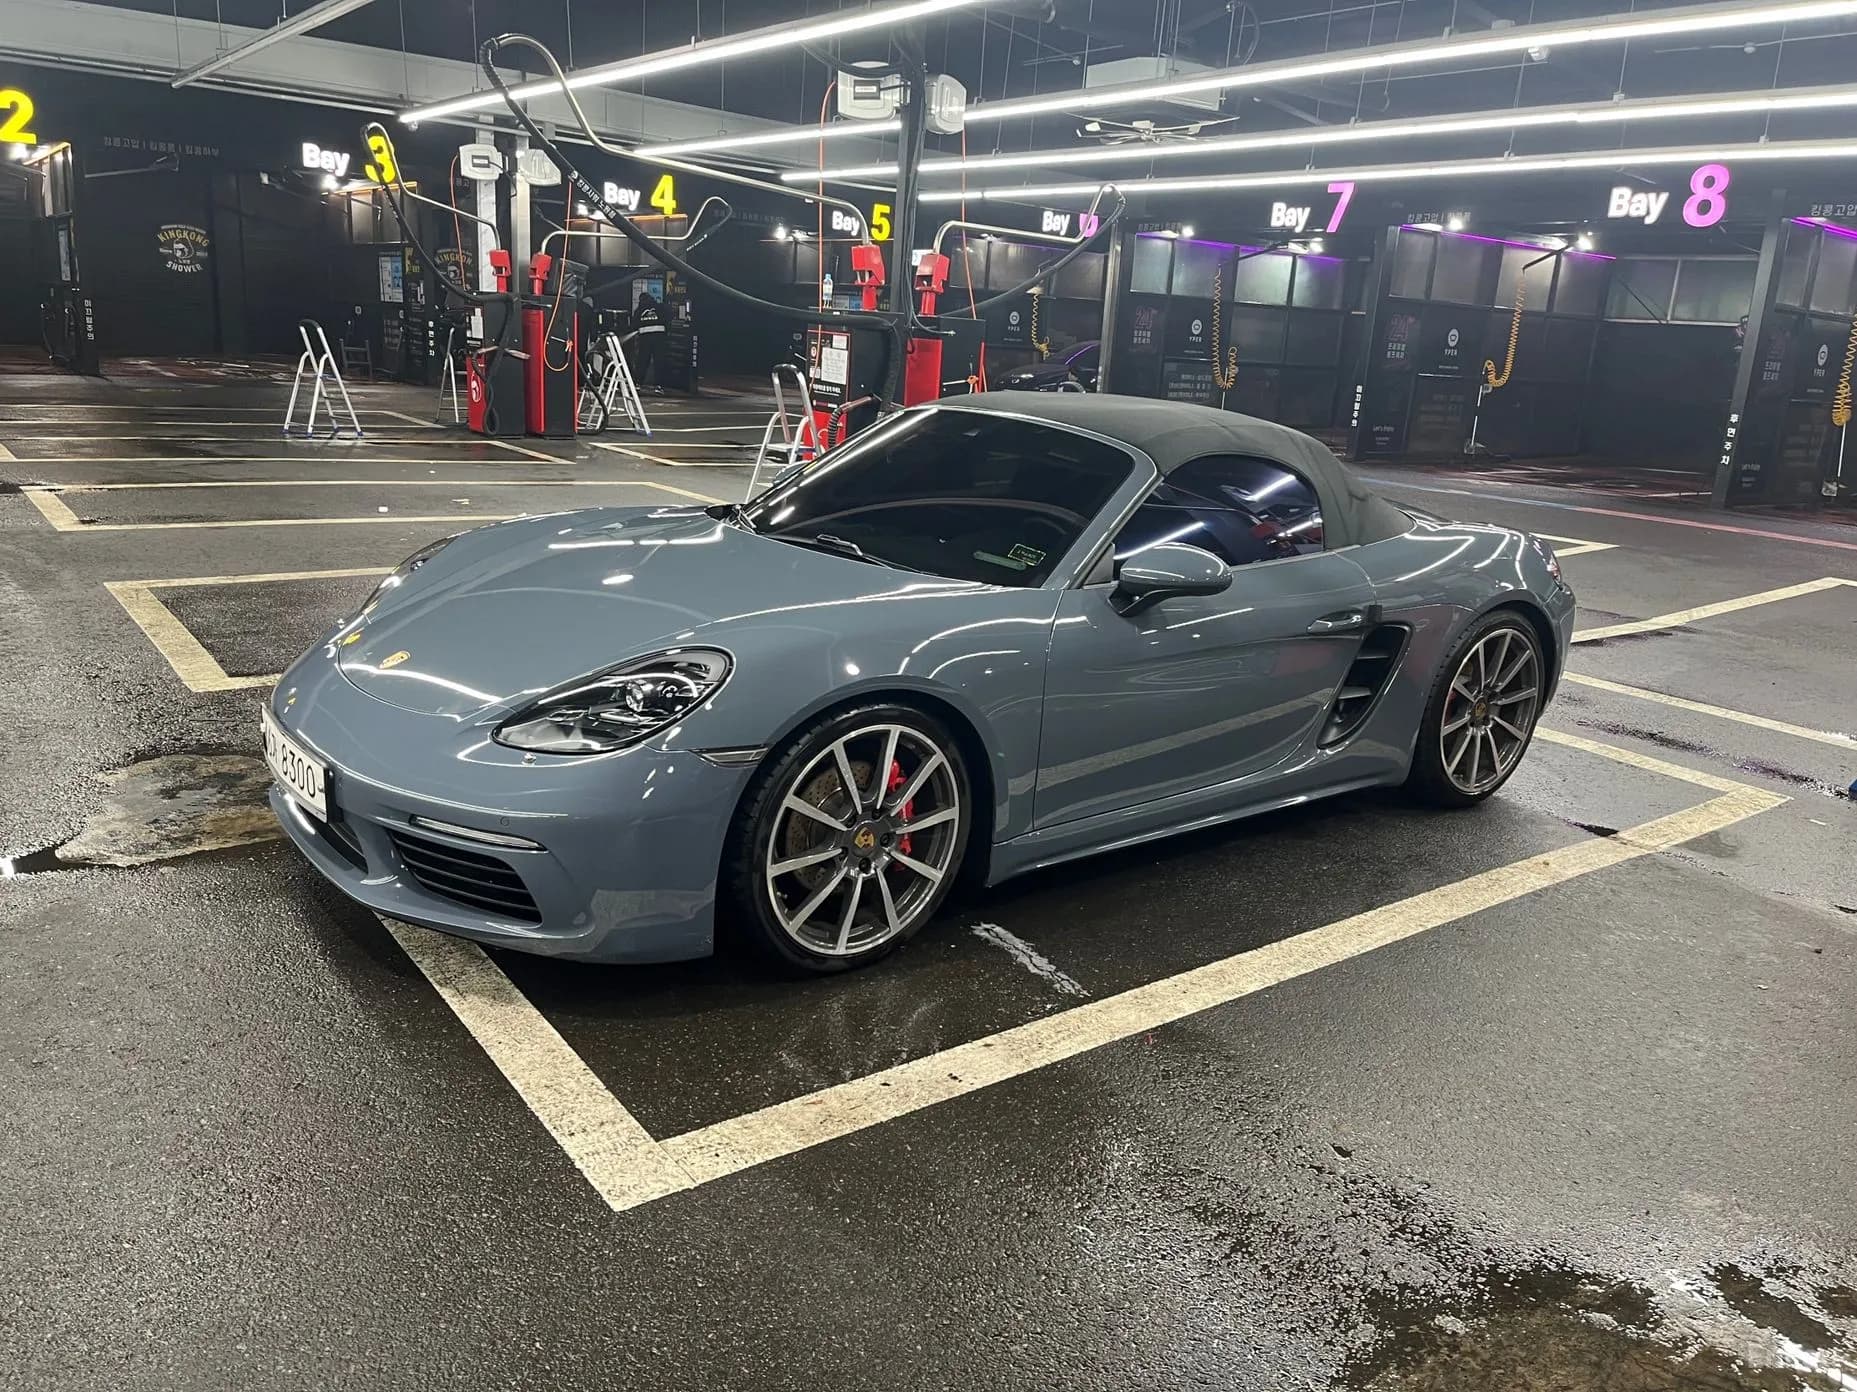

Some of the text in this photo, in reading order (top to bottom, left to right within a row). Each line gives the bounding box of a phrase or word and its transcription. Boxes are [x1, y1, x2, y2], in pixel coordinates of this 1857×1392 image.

[0, 89, 37, 145] 2
[302, 135, 396, 184] Bay 3
[604, 181, 641, 211] Bay
[650, 174, 677, 216] 4
[1270, 181, 1355, 233] Bay 7
[1607, 163, 1730, 228] Bay 8
[157, 229, 210, 247] KINGKONG
[832, 203, 891, 241] Bay 5
[1042, 211, 1071, 236] Bay
[166, 260, 203, 273] SHOWER
[1719, 413, 1740, 466] 후면주차
[281, 743, 316, 798] 8300
